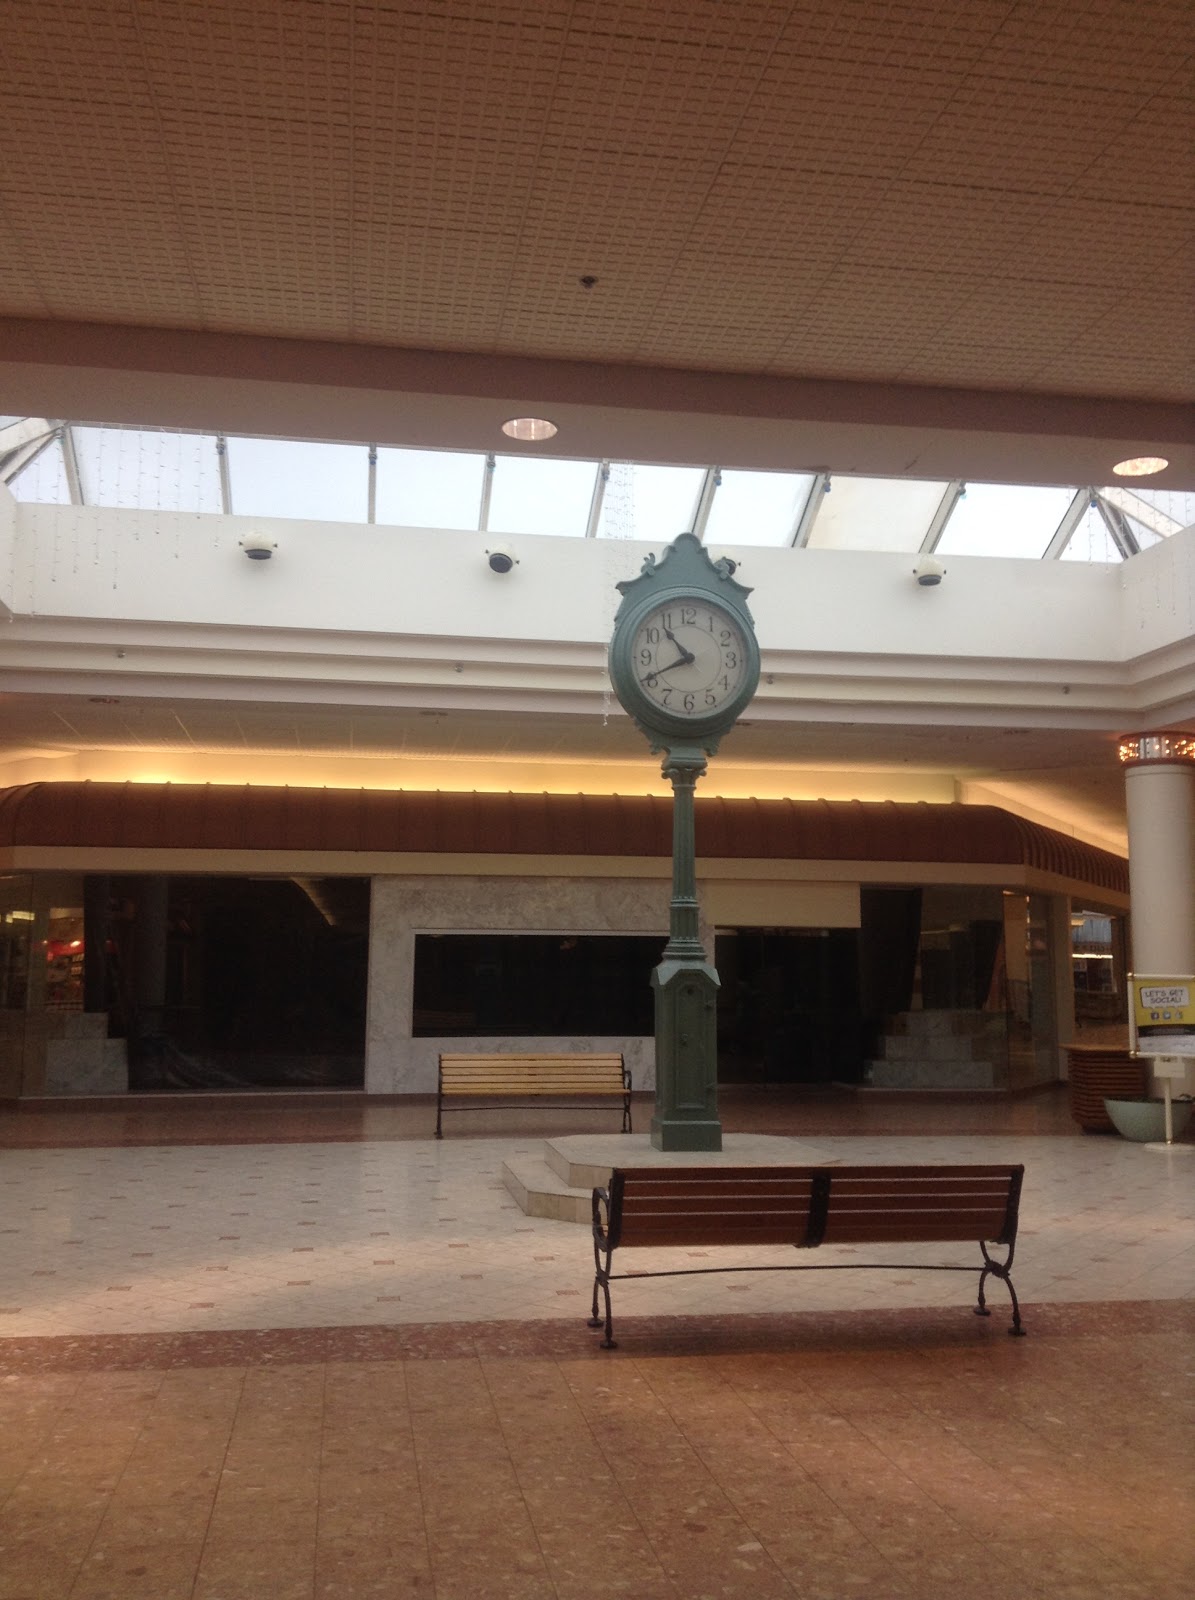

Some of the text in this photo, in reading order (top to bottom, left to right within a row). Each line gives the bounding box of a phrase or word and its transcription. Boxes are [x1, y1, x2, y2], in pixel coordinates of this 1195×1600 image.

[662, 613, 672, 629] 11
[680, 608, 697, 625] 12
[709, 617, 714, 632] 1
[645, 627, 660, 644] 10
[720, 630, 731, 647] 2
[640, 648, 652, 666] 9
[725, 651, 737, 669] 3
[718, 675, 729, 691] 4
[662, 688, 673, 705] 7
[683, 693, 695, 711] 6
[705, 689, 716, 705] 5
